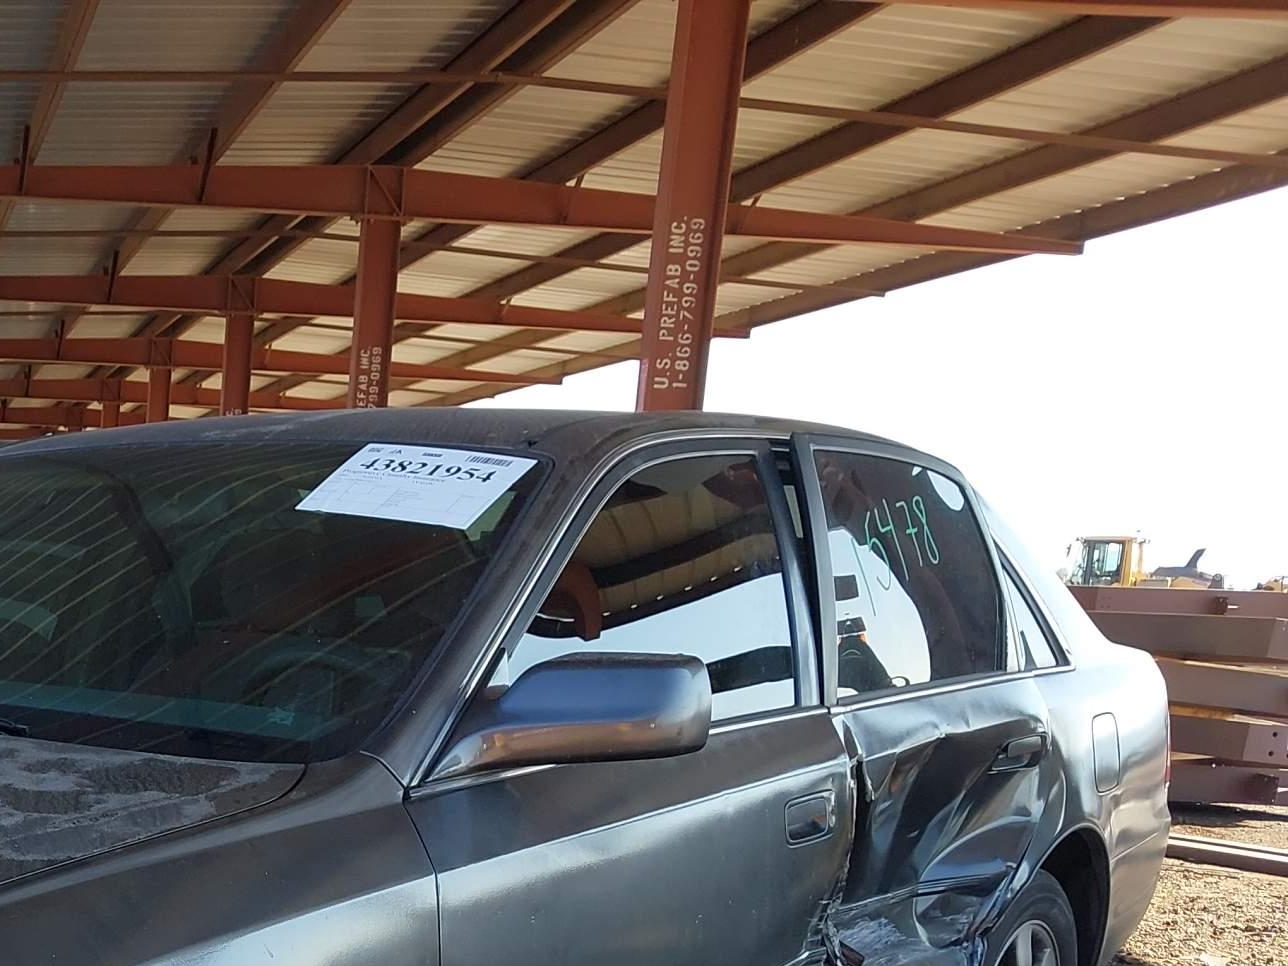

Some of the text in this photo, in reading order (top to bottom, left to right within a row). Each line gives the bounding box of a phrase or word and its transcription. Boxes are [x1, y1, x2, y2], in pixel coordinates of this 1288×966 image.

[653, 215, 688, 389] U.S. PREFAB INC.
[672, 217, 706, 388] 1-866-799-0969
[359, 457, 497, 483] 43821954
